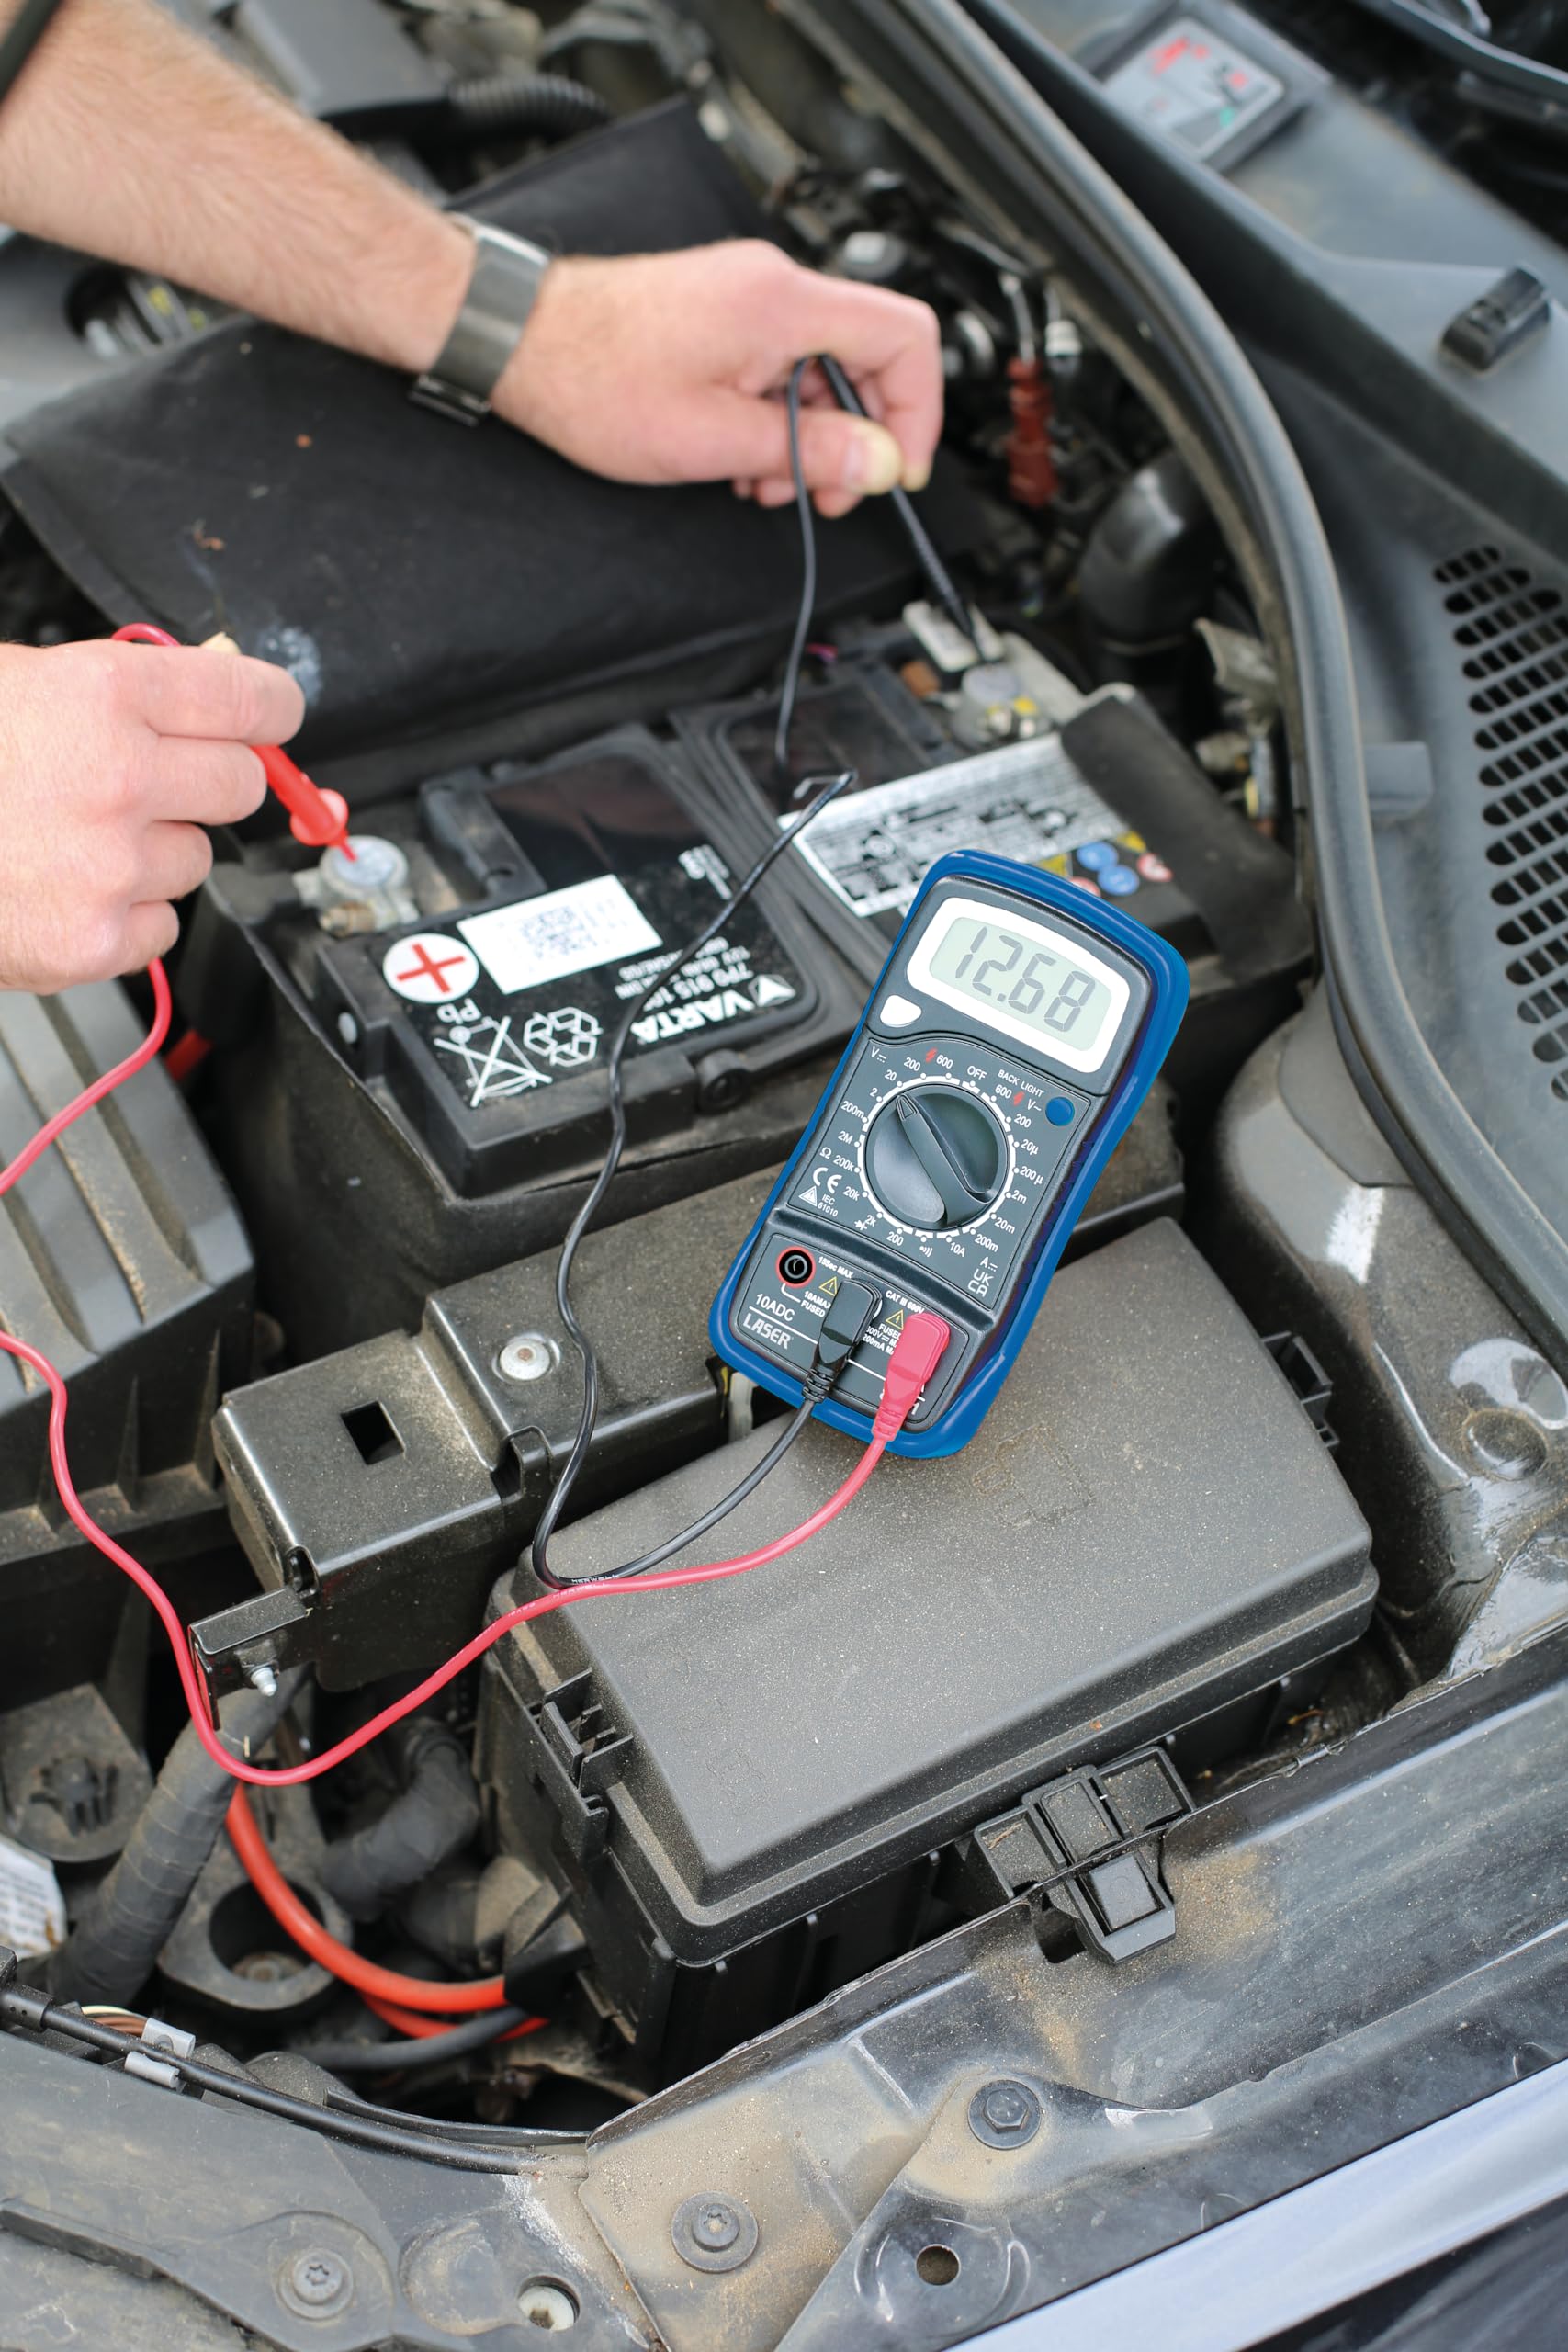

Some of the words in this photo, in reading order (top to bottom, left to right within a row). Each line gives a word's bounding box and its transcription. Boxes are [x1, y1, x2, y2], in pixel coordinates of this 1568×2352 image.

[955, 926, 1096, 1033] 12.68
[436, 998, 481, 1024] Pb
[630, 989, 755, 1044] VARTA
[904, 1057, 921, 1072] 200
[936, 1055, 953, 1069] 600
[885, 1069, 897, 1081] 20
[967, 1066, 987, 1080] OFF
[998, 1069, 1019, 1086] BACK
[1021, 1080, 1044, 1098] LIGHT
[869, 1087, 878, 1098] 2
[995, 1084, 1012, 1100] 600
[841, 1101, 864, 1119] 200m
[1014, 1114, 1032, 1128] 200
[838, 1131, 852, 1145] 2M
[833, 1155, 854, 1172] 200k
[822, 1193, 836, 1206] IEC
[843, 1186, 860, 1202] 20k
[1012, 1190, 1027, 1204] 2m
[818, 1202, 839, 1217] 61010
[865, 1214, 876, 1227] 2k
[995, 1216, 1015, 1234] 20m
[886, 1231, 904, 1247] 200
[975, 1233, 999, 1252] 200m
[950, 1241, 965, 1258] 10A
[837, 1265, 854, 1279] MAX
[973, 1269, 996, 1287] UK
[886, 1290, 901, 1303] CAT
[968, 1280, 989, 1297] CA
[756, 1293, 795, 1322] 10ADC
[800, 1299, 826, 1317] FUSED
[742, 1313, 791, 1350] LASER
